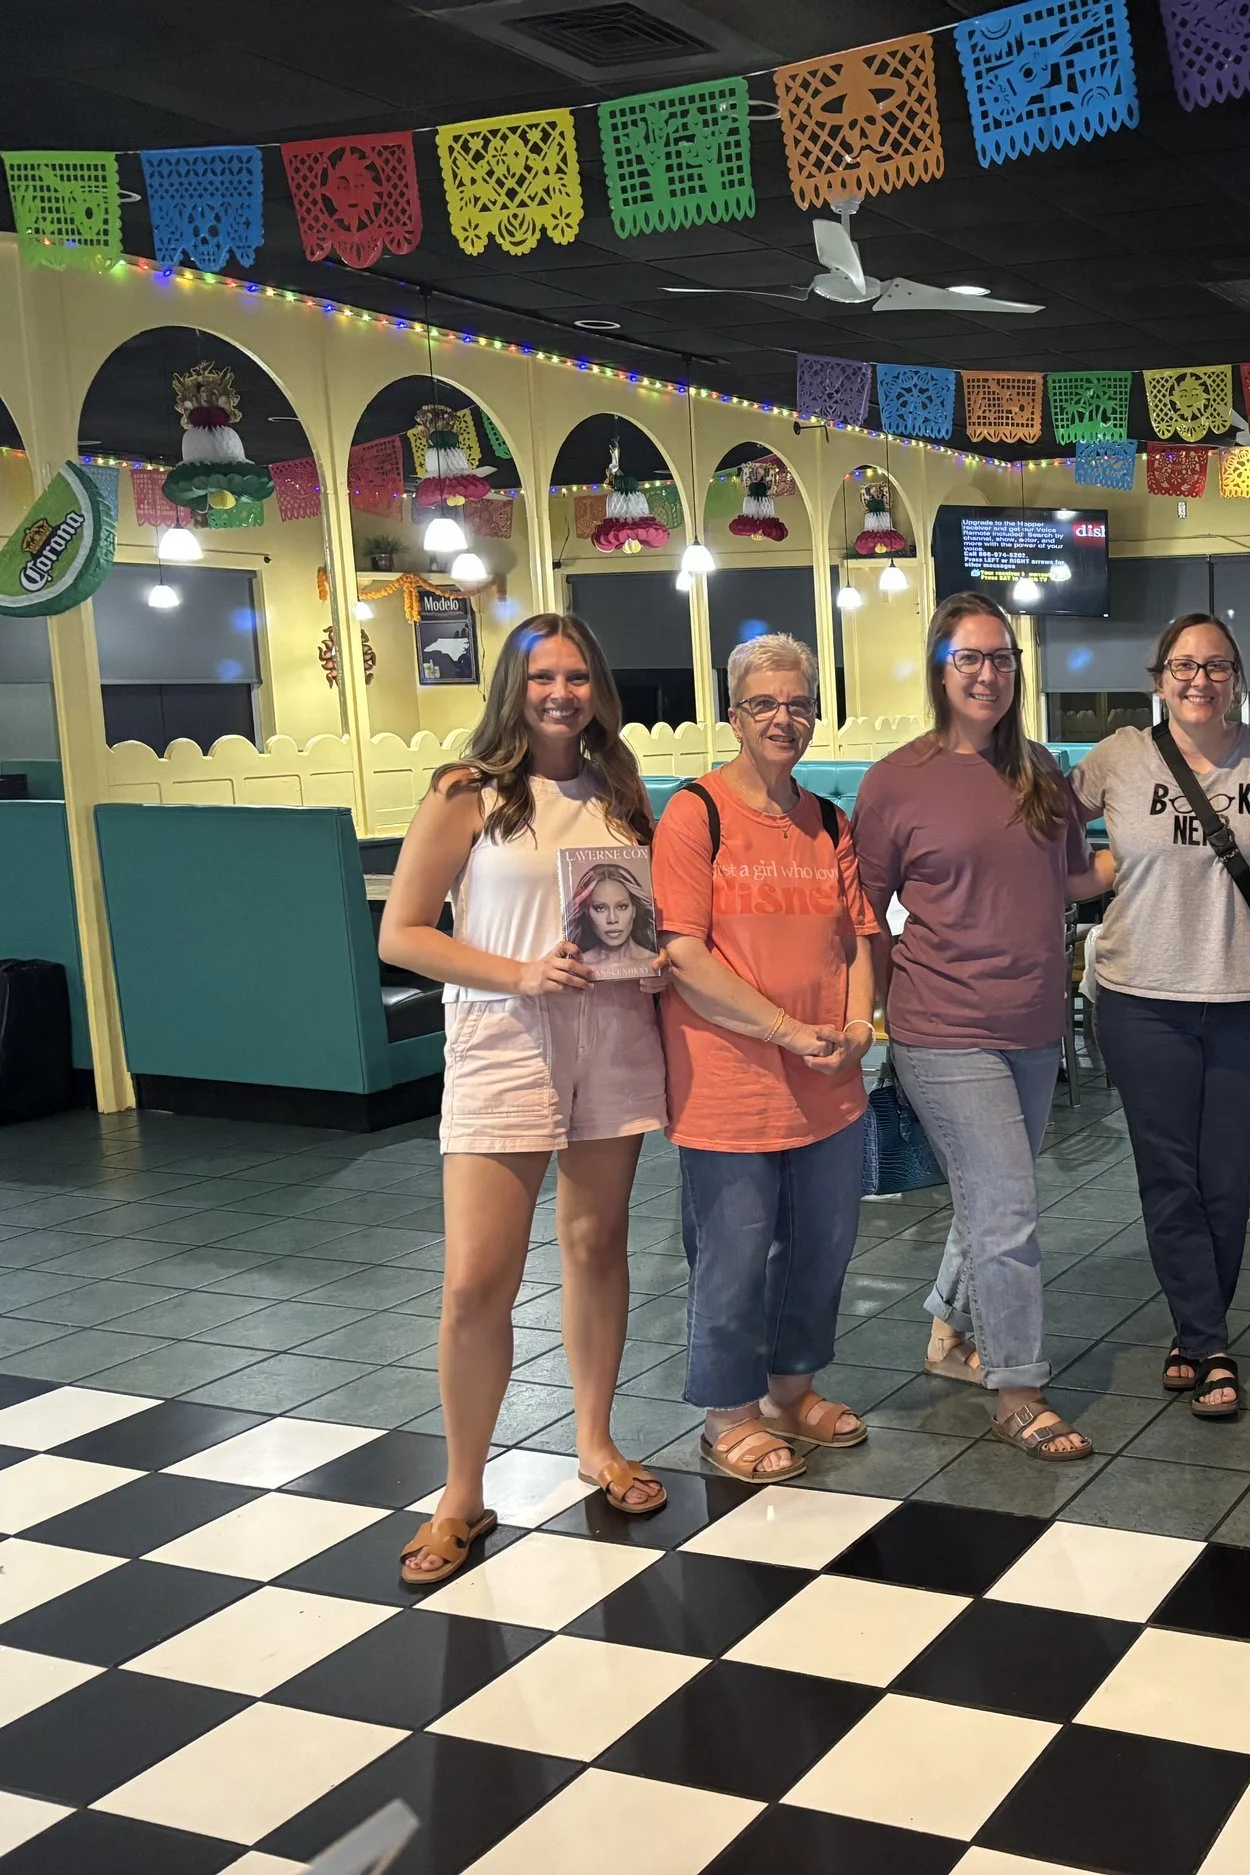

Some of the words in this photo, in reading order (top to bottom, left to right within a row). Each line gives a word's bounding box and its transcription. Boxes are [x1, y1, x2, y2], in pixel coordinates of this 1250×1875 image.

[962, 519, 994, 527] Upgrade
[20, 511, 85, 592] Corona
[423, 596, 459, 611] Modelo
[565, 849, 621, 861] LAVERNE
[622, 848, 648, 860] COX
[739, 864, 750, 877] a
[752, 859, 778, 881] girl
[780, 860, 813, 879] who
